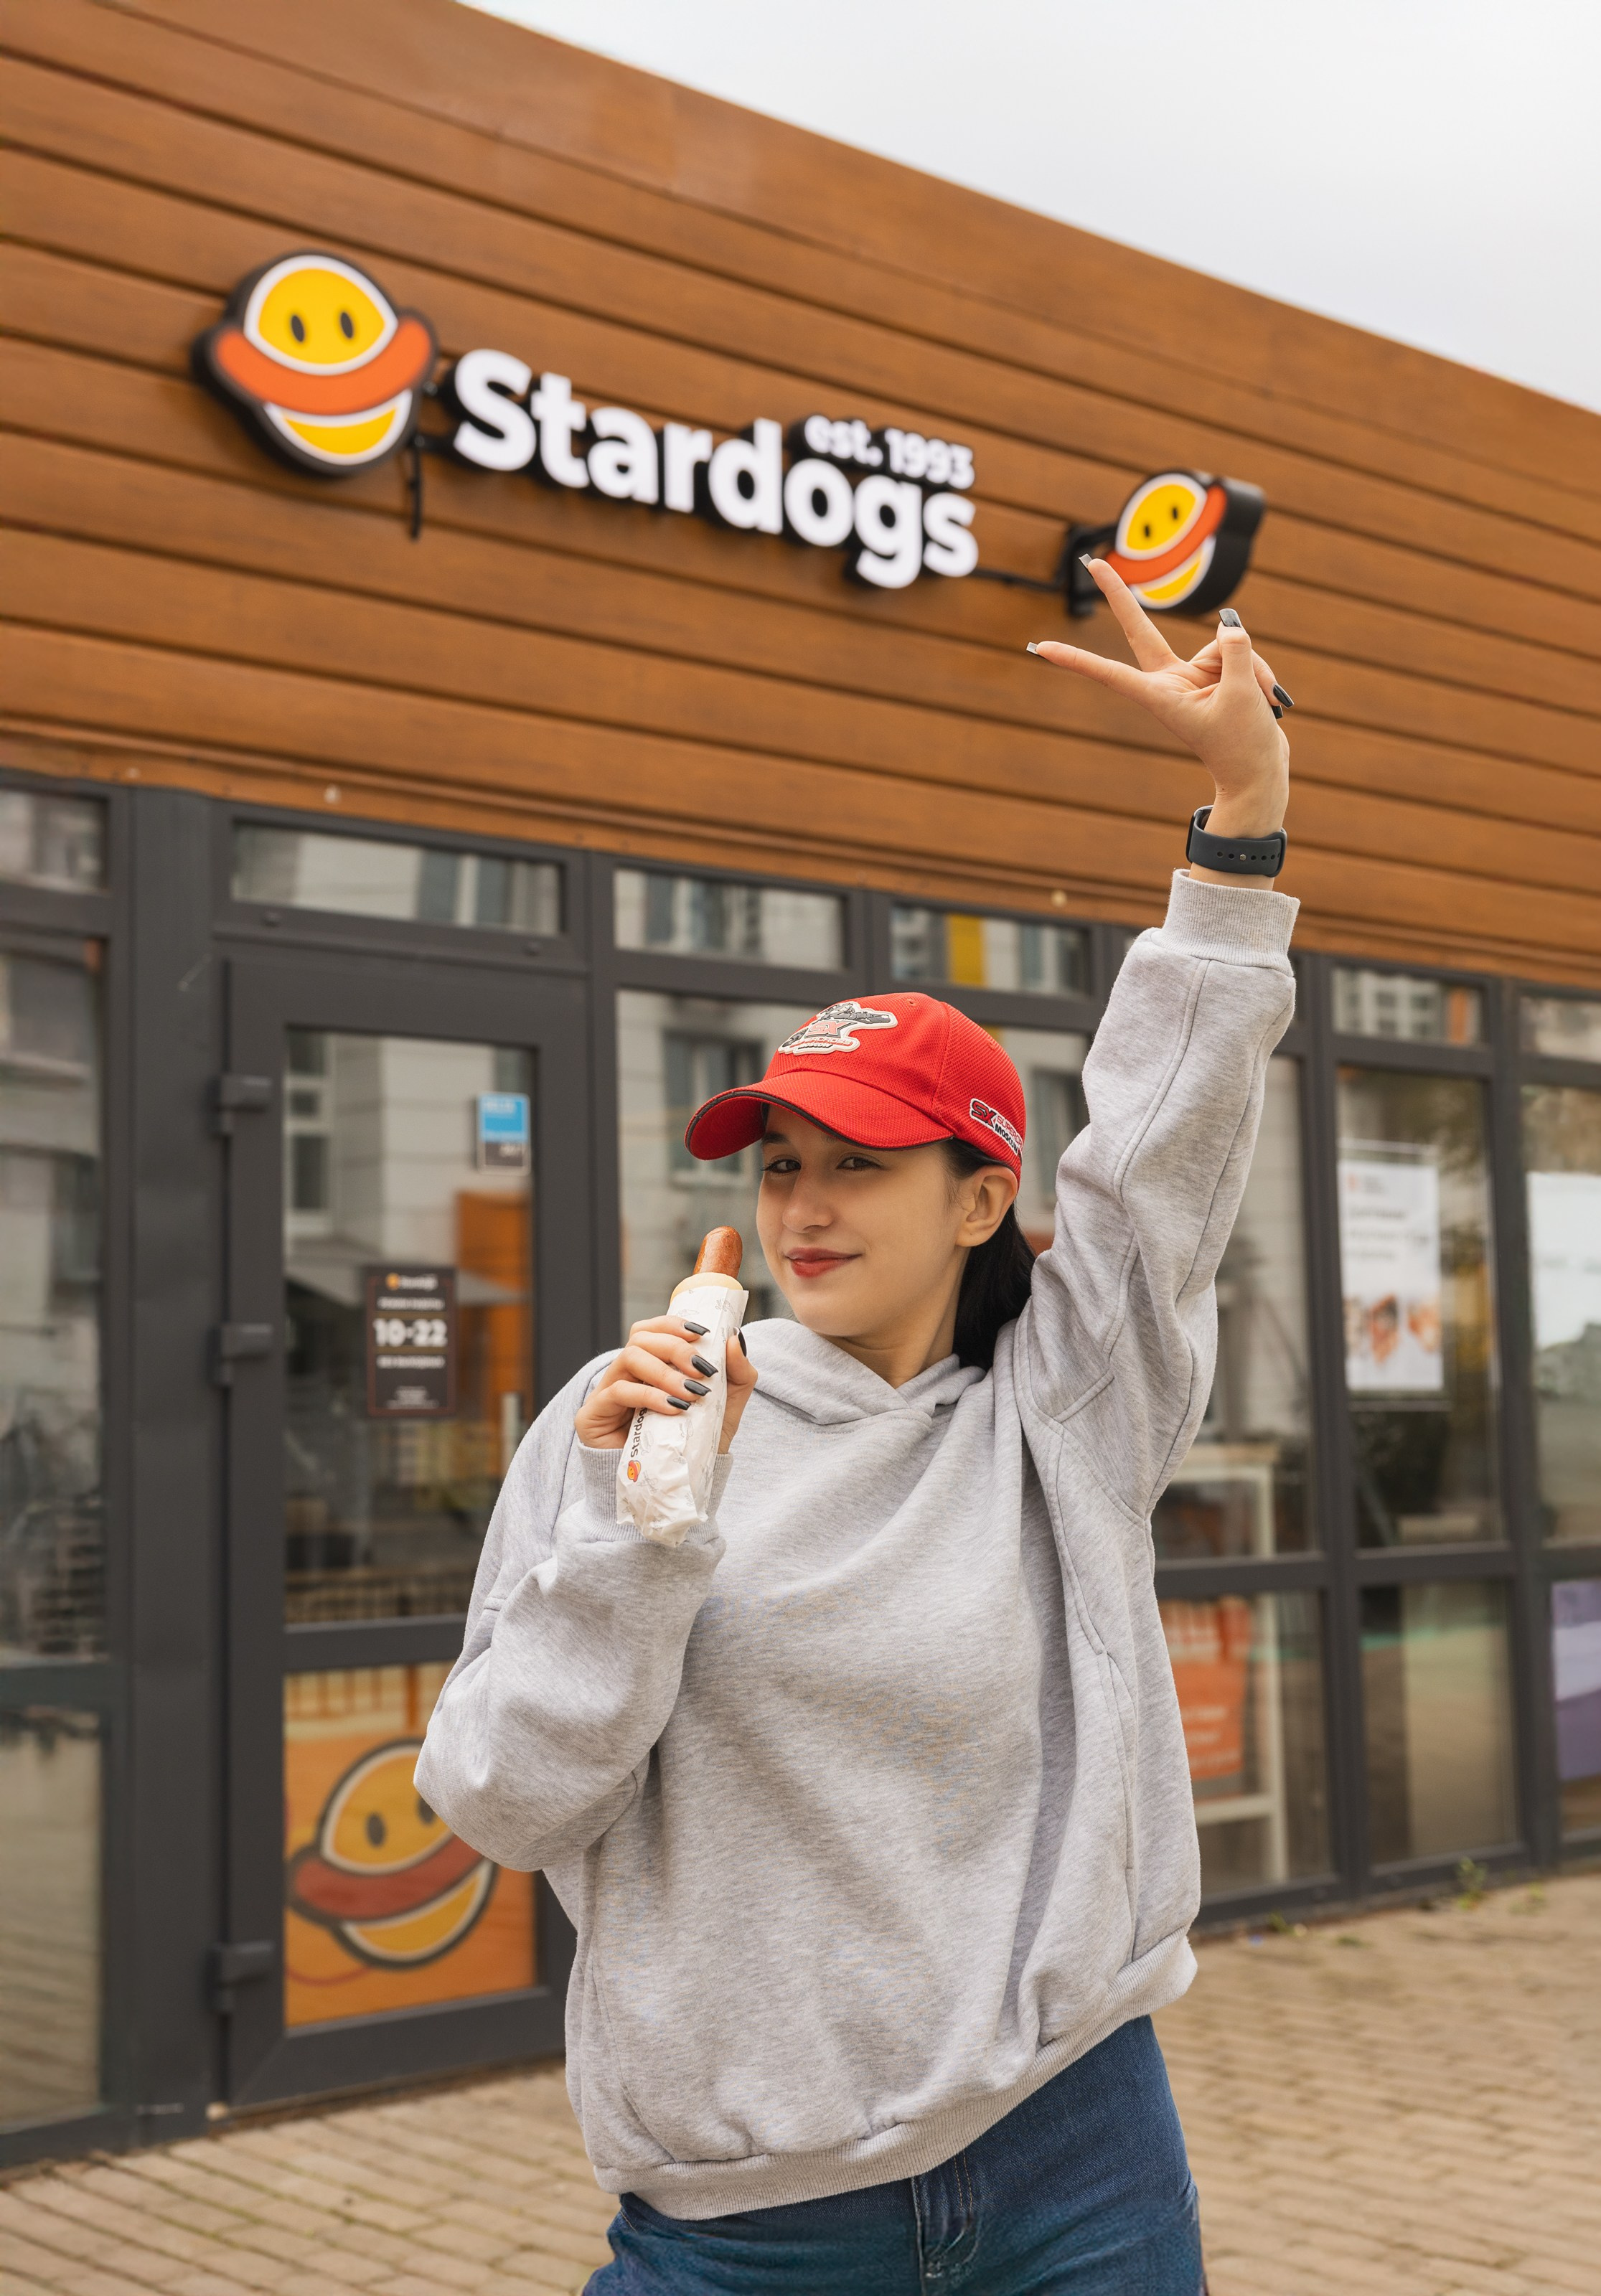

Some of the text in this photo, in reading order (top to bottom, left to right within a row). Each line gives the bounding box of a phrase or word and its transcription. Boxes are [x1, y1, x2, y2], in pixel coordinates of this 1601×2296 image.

[454, 349, 978, 588] Stardogs
[804, 415, 975, 489] est. 1993
[972, 1100, 997, 1129] SX
[995, 1123, 1018, 1154] MOSCOW
[372, 1318, 448, 1347] 10-22
[631, 1408, 647, 1458] Stardog
